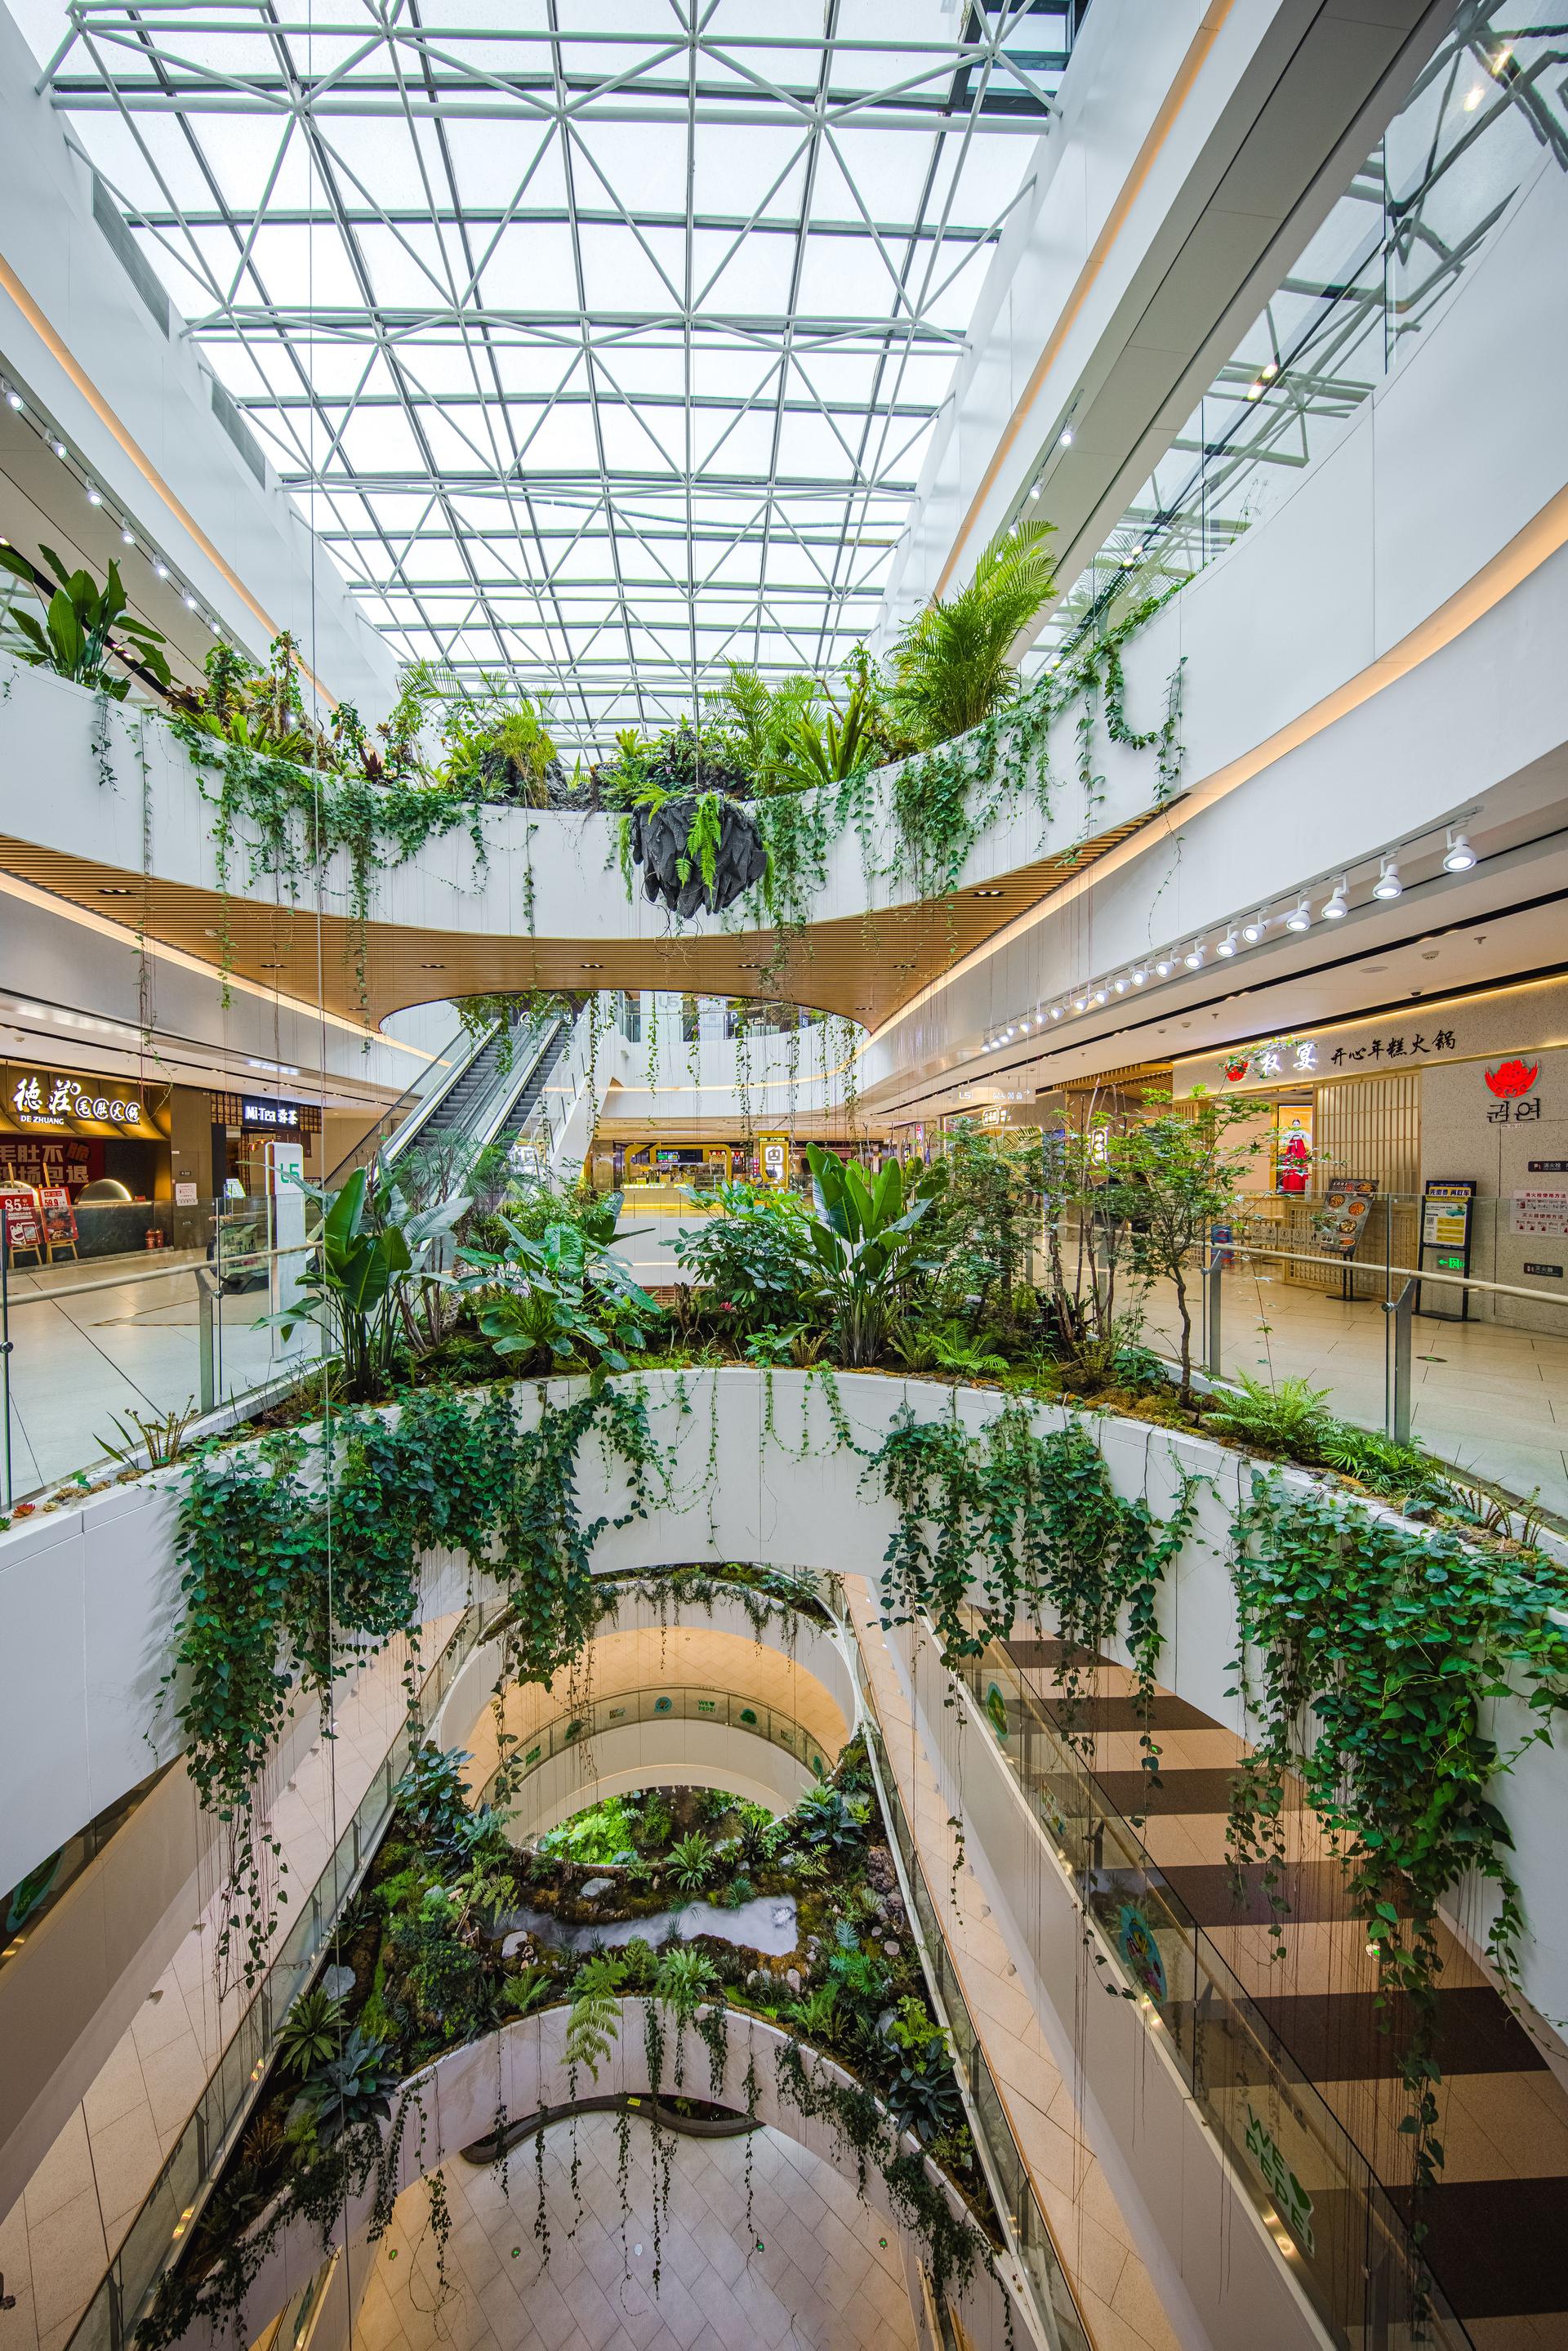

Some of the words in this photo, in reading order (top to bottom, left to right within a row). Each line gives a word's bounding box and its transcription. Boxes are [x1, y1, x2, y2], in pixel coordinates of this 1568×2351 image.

[730, 1011, 738, 1022] P
[1486, 1098, 1541, 1123] 권연
[33, 1116, 64, 1125] ZHUANG
[5, 1198, 22, 1211] 85
[44, 1198, 59, 1207] 59.9
[1248, 2103, 1285, 2179] WE
[1245, 2128, 1312, 2254] PEPE!
